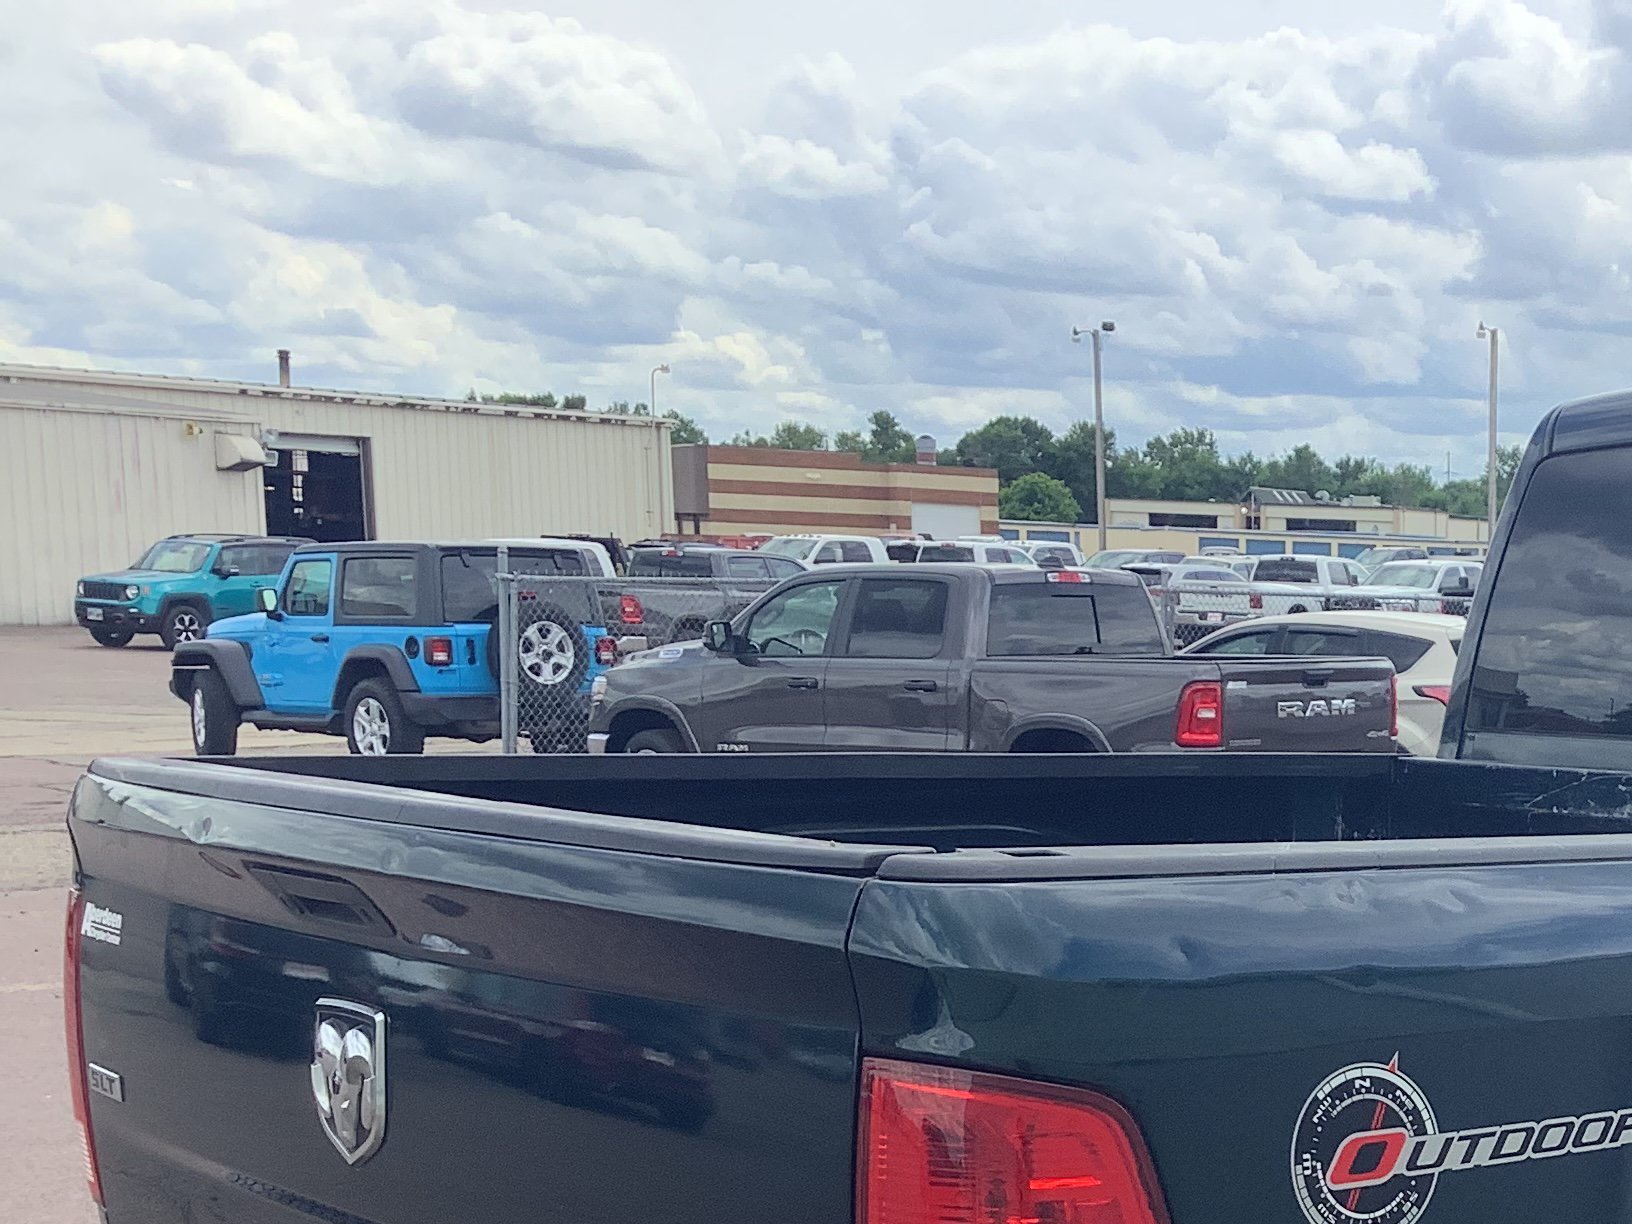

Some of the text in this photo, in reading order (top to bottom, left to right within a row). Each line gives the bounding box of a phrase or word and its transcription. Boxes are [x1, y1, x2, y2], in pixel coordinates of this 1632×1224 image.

[1277, 699, 1356, 718] RAM
[91, 1069, 115, 1096] SLT
[1355, 1077, 1371, 1088] N
